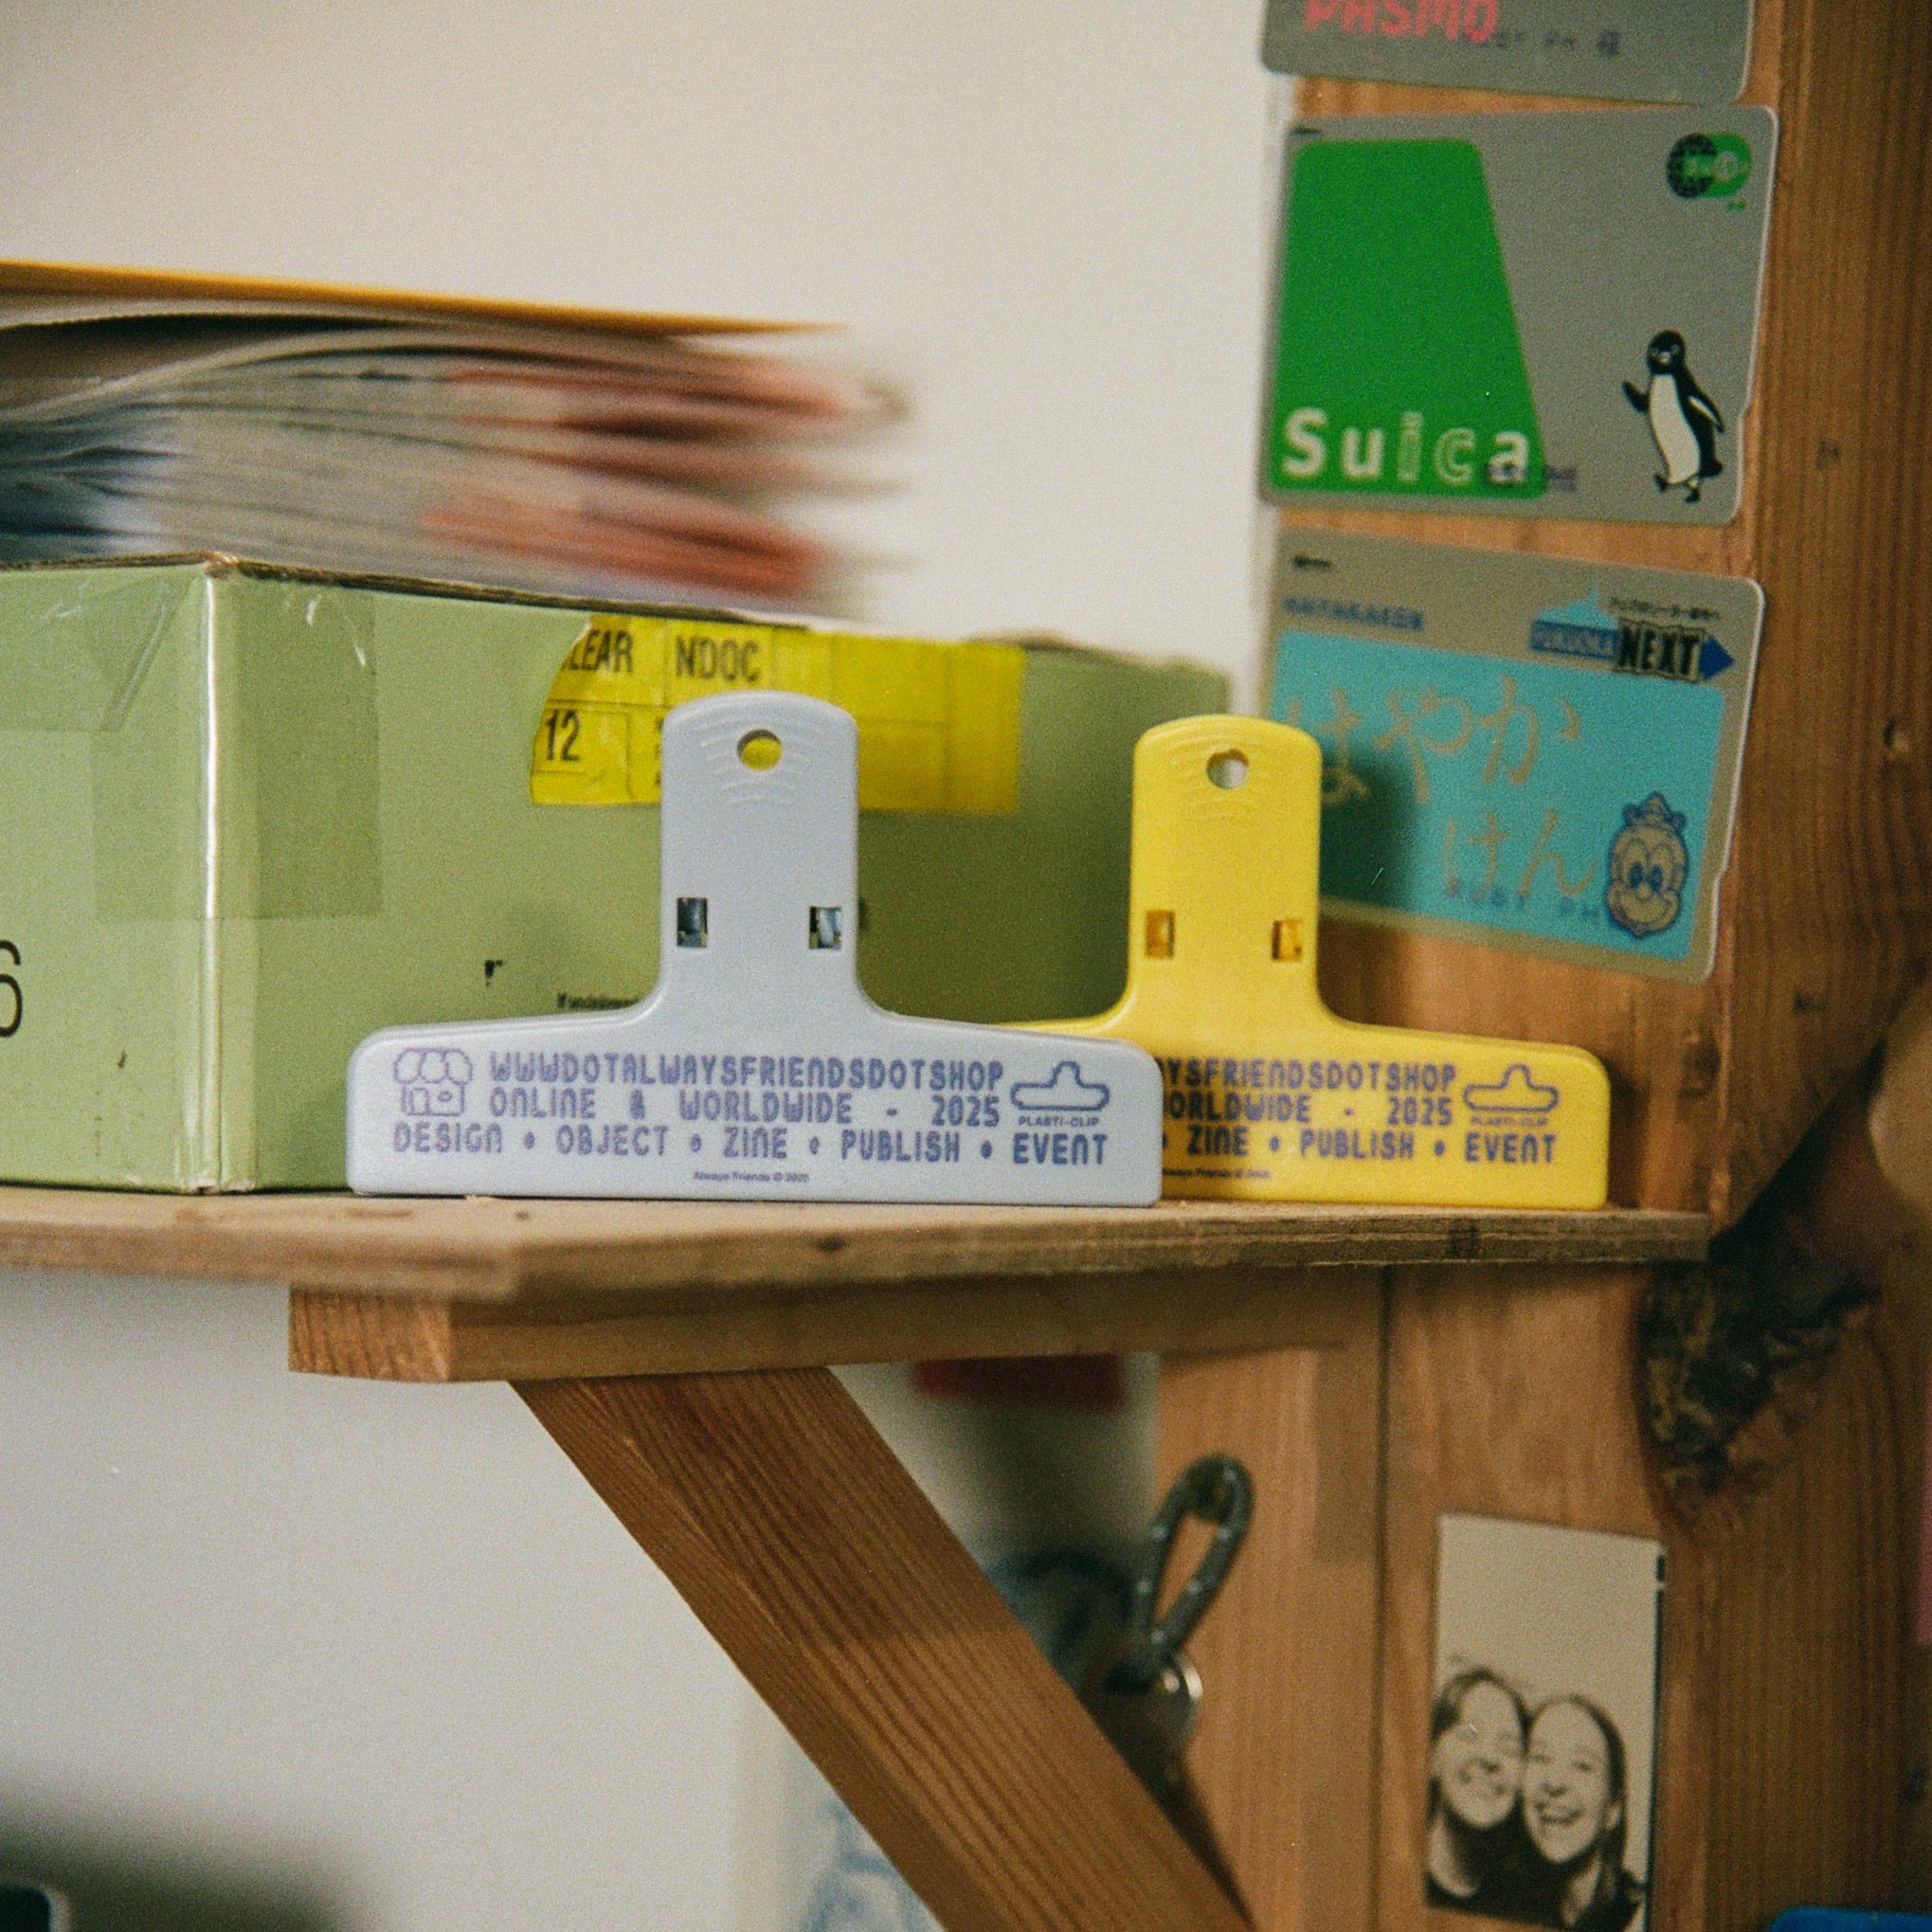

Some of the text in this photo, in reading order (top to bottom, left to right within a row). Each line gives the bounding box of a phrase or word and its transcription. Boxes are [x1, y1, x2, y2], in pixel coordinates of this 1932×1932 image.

[1282, 407, 1529, 485] Suica
[676, 634, 761, 682] NDOC
[1617, 624, 1702, 677] NEXT
[544, 709, 584, 762] 12
[1440, 808, 1598, 902] けん
[489, 1050, 1003, 1091] WWWDOTALWAYSFRIENDSDOTSHOP
[1155, 1056, 1457, 1092] YSFRIENDSDOTSHOP
[489, 1087, 597, 1120] ONLINE
[679, 1090, 853, 1125] WORLDWIDE
[930, 1094, 1001, 1128] 2025
[1163, 1091, 1310, 1123] ORLDWIDE
[1386, 1095, 1454, 1127] 2025
[392, 1121, 1108, 1165] DESIGN OBJECT ZINE PUBLISH EVENT
[1187, 1124, 1557, 1165] ZINE PUBLISH EVENT
